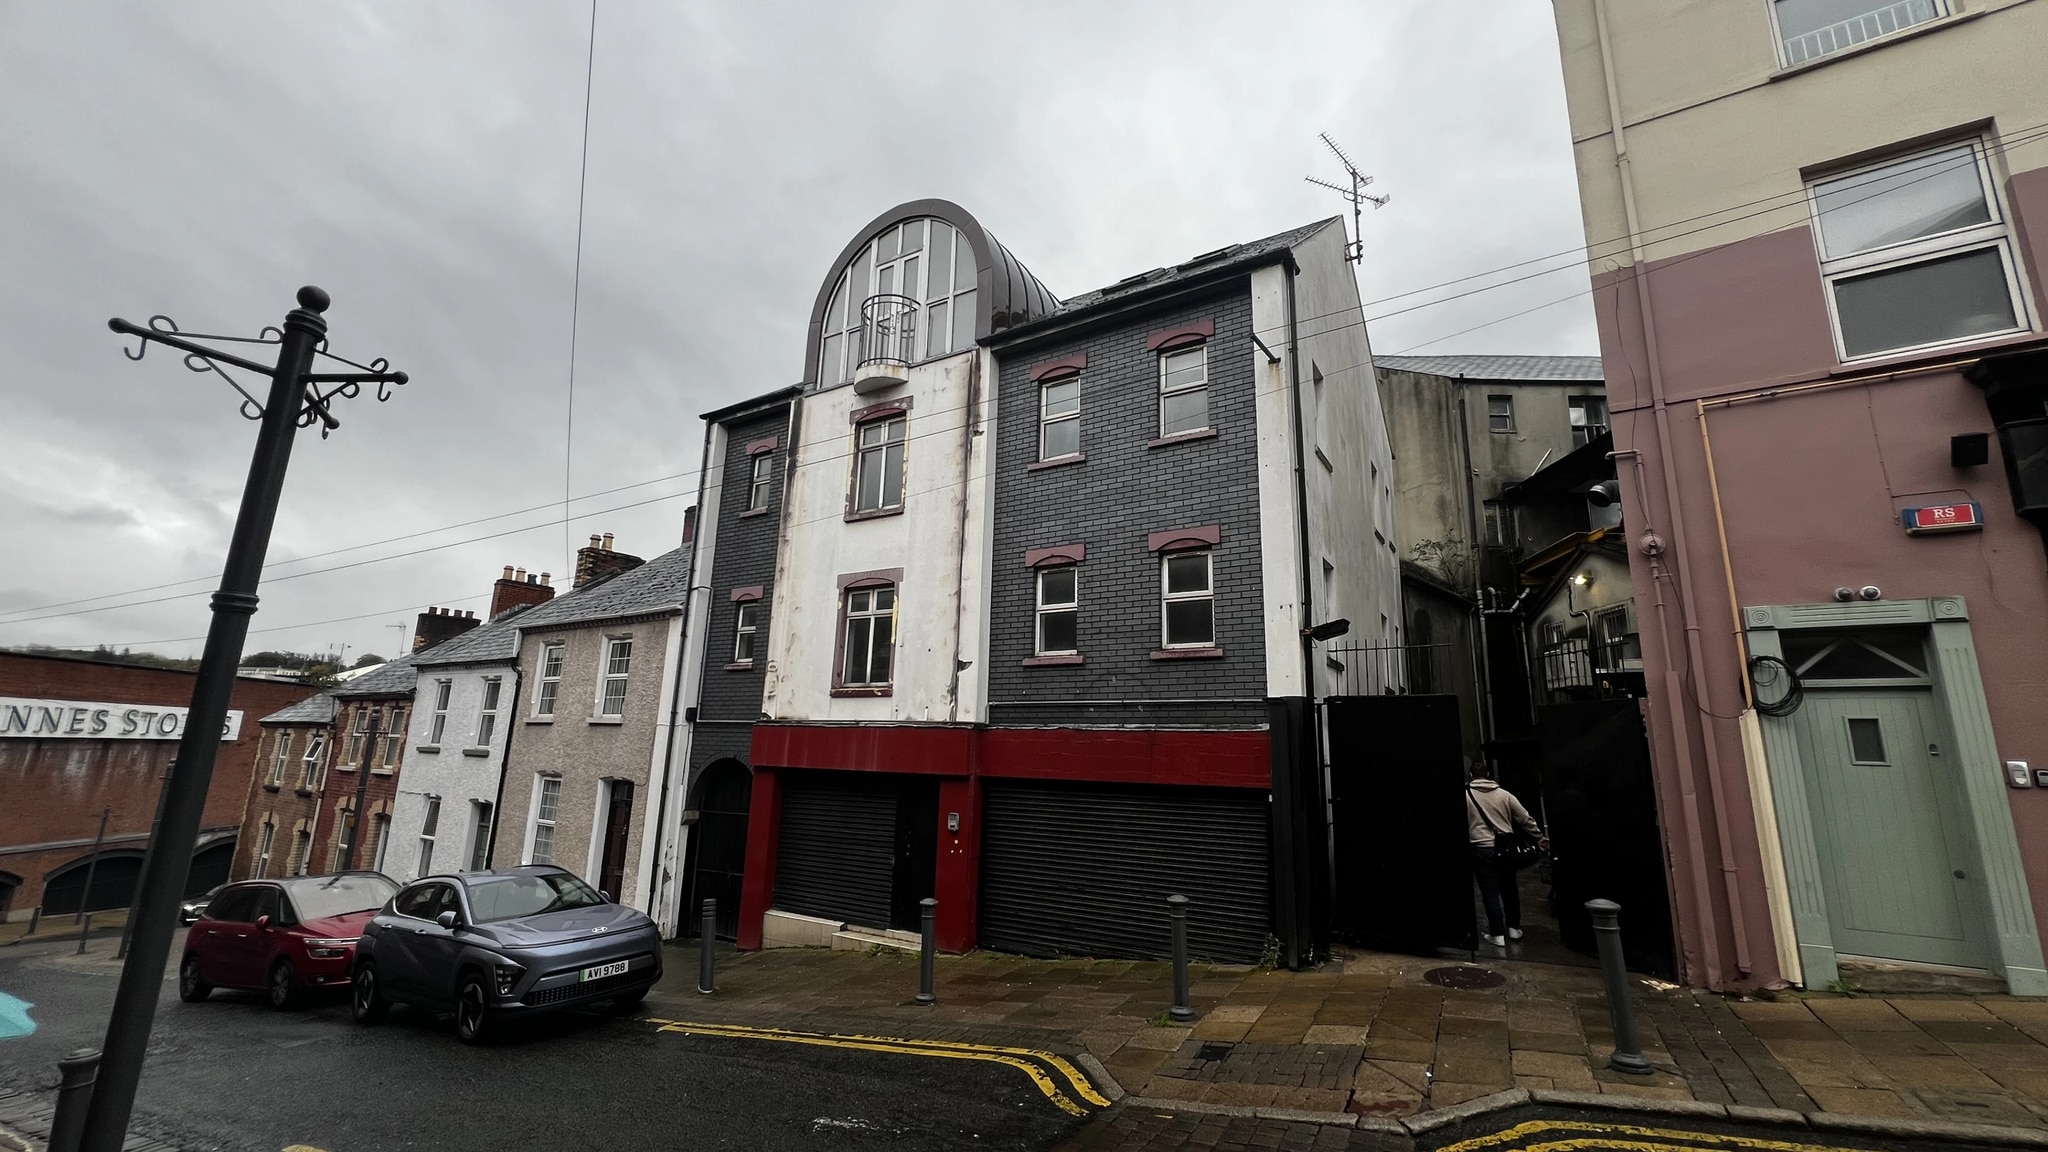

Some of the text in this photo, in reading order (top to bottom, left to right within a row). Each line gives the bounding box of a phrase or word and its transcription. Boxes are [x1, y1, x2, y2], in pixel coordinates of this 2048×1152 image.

[1933, 507, 1955, 518] RS
[119, 708, 232, 737] STOS
[603, 962, 626, 976] 9788
